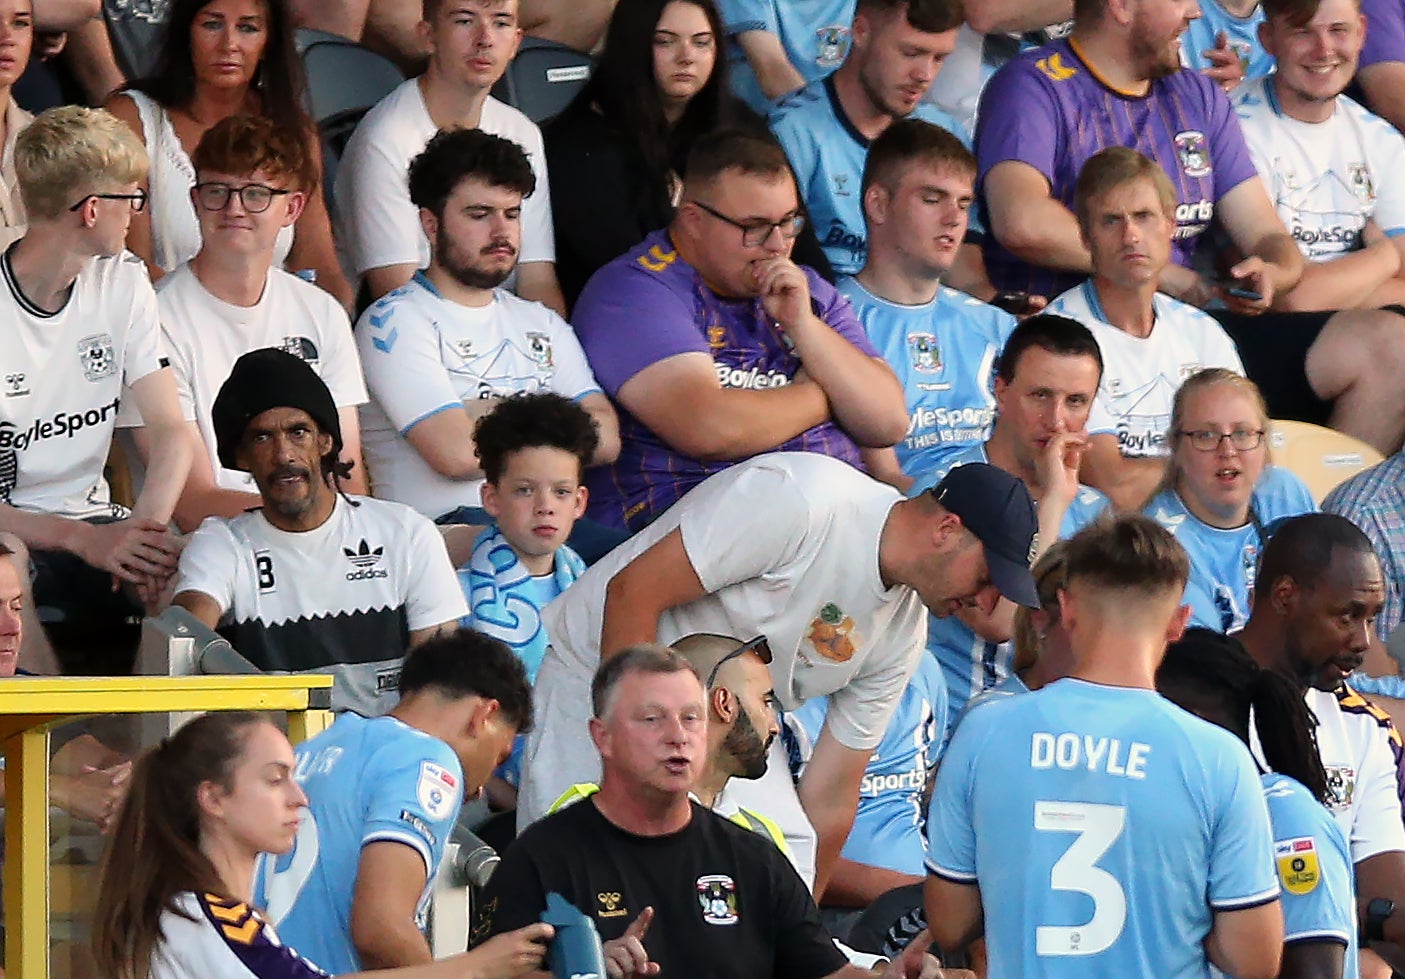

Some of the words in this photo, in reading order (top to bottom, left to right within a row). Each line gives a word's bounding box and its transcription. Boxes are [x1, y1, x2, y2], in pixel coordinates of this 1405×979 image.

[346, 567, 388, 582] adidas
[1031, 732, 1151, 780] DOYLE
[1034, 801, 1128, 956] 3
